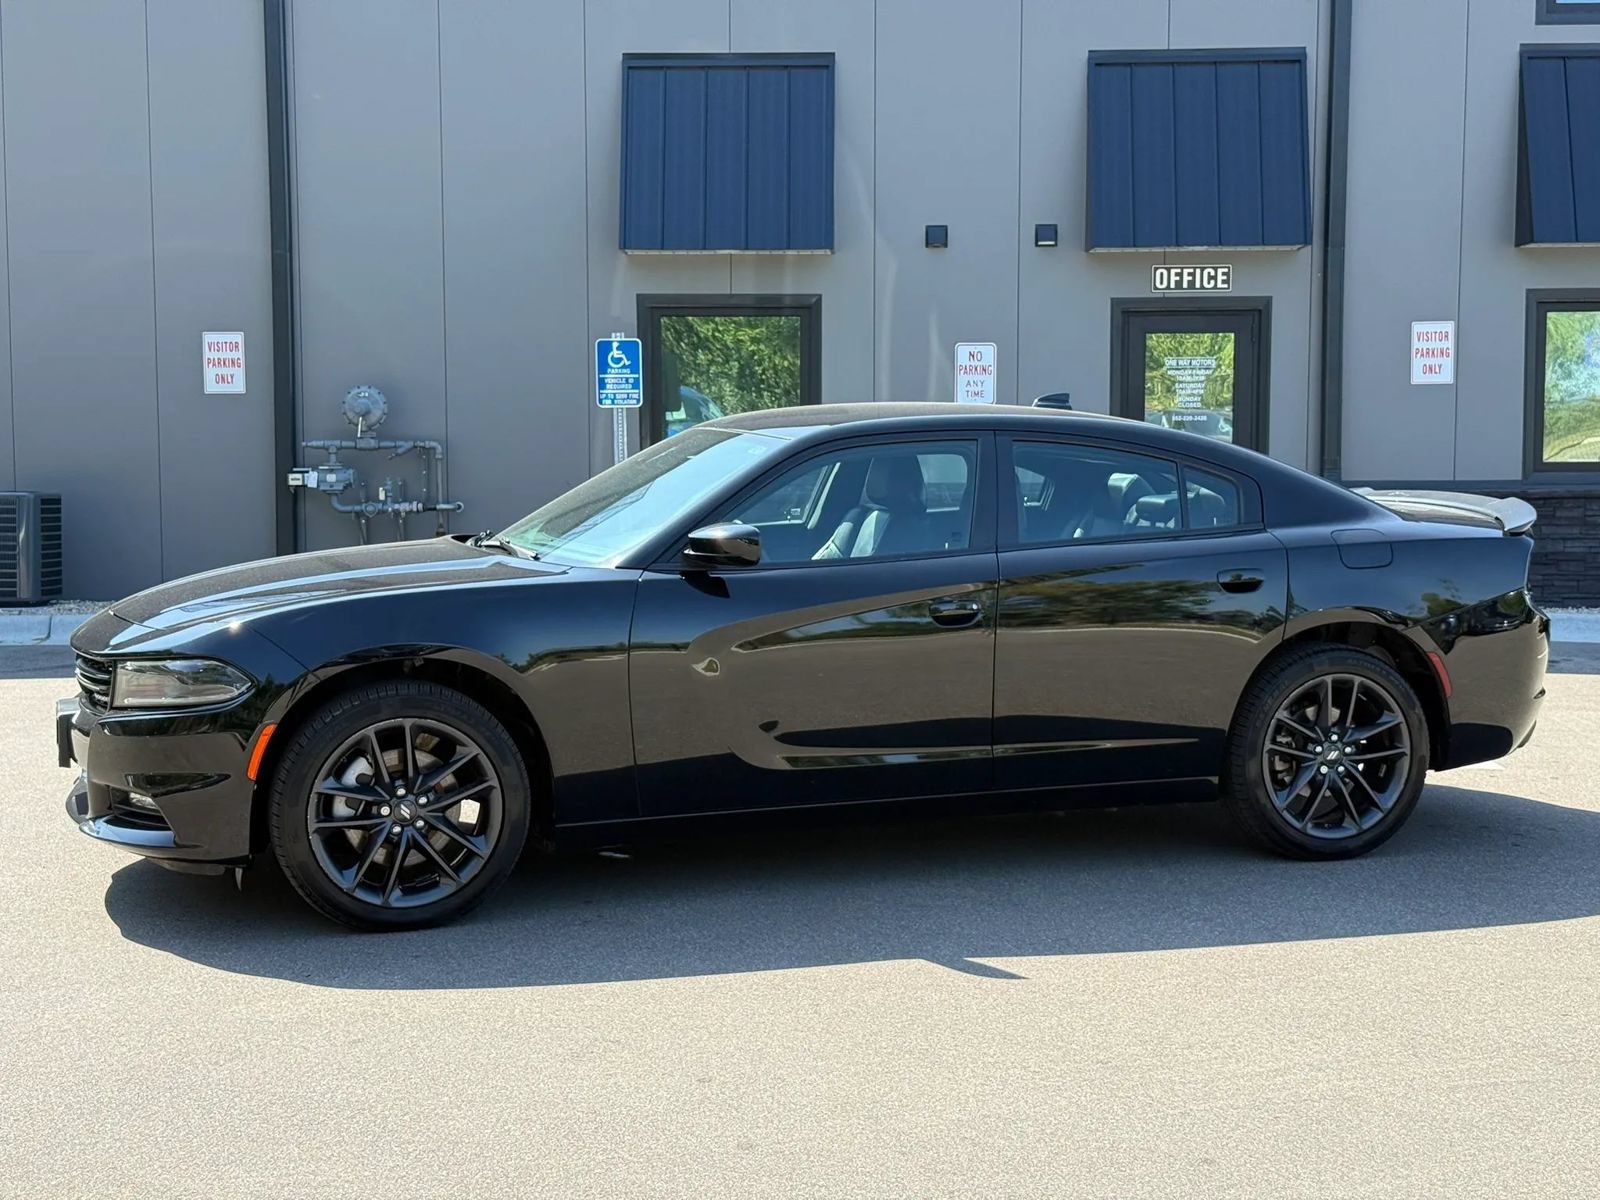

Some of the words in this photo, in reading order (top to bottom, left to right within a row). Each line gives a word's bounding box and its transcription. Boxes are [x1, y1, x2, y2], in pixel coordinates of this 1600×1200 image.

[1155, 267, 1229, 289] OFFICE
[1416, 331, 1449, 342] VISITOR
[207, 341, 240, 353] VISITOR
[1415, 347, 1450, 358] PARKING
[968, 351, 983, 361] NO
[207, 357, 241, 368] PARKING
[959, 364, 992, 376] PARKING
[1422, 363, 1442, 375] ONLY
[215, 373, 235, 384] ONLY
[965, 380, 985, 388] ANY
[965, 390, 985, 398] TIME
